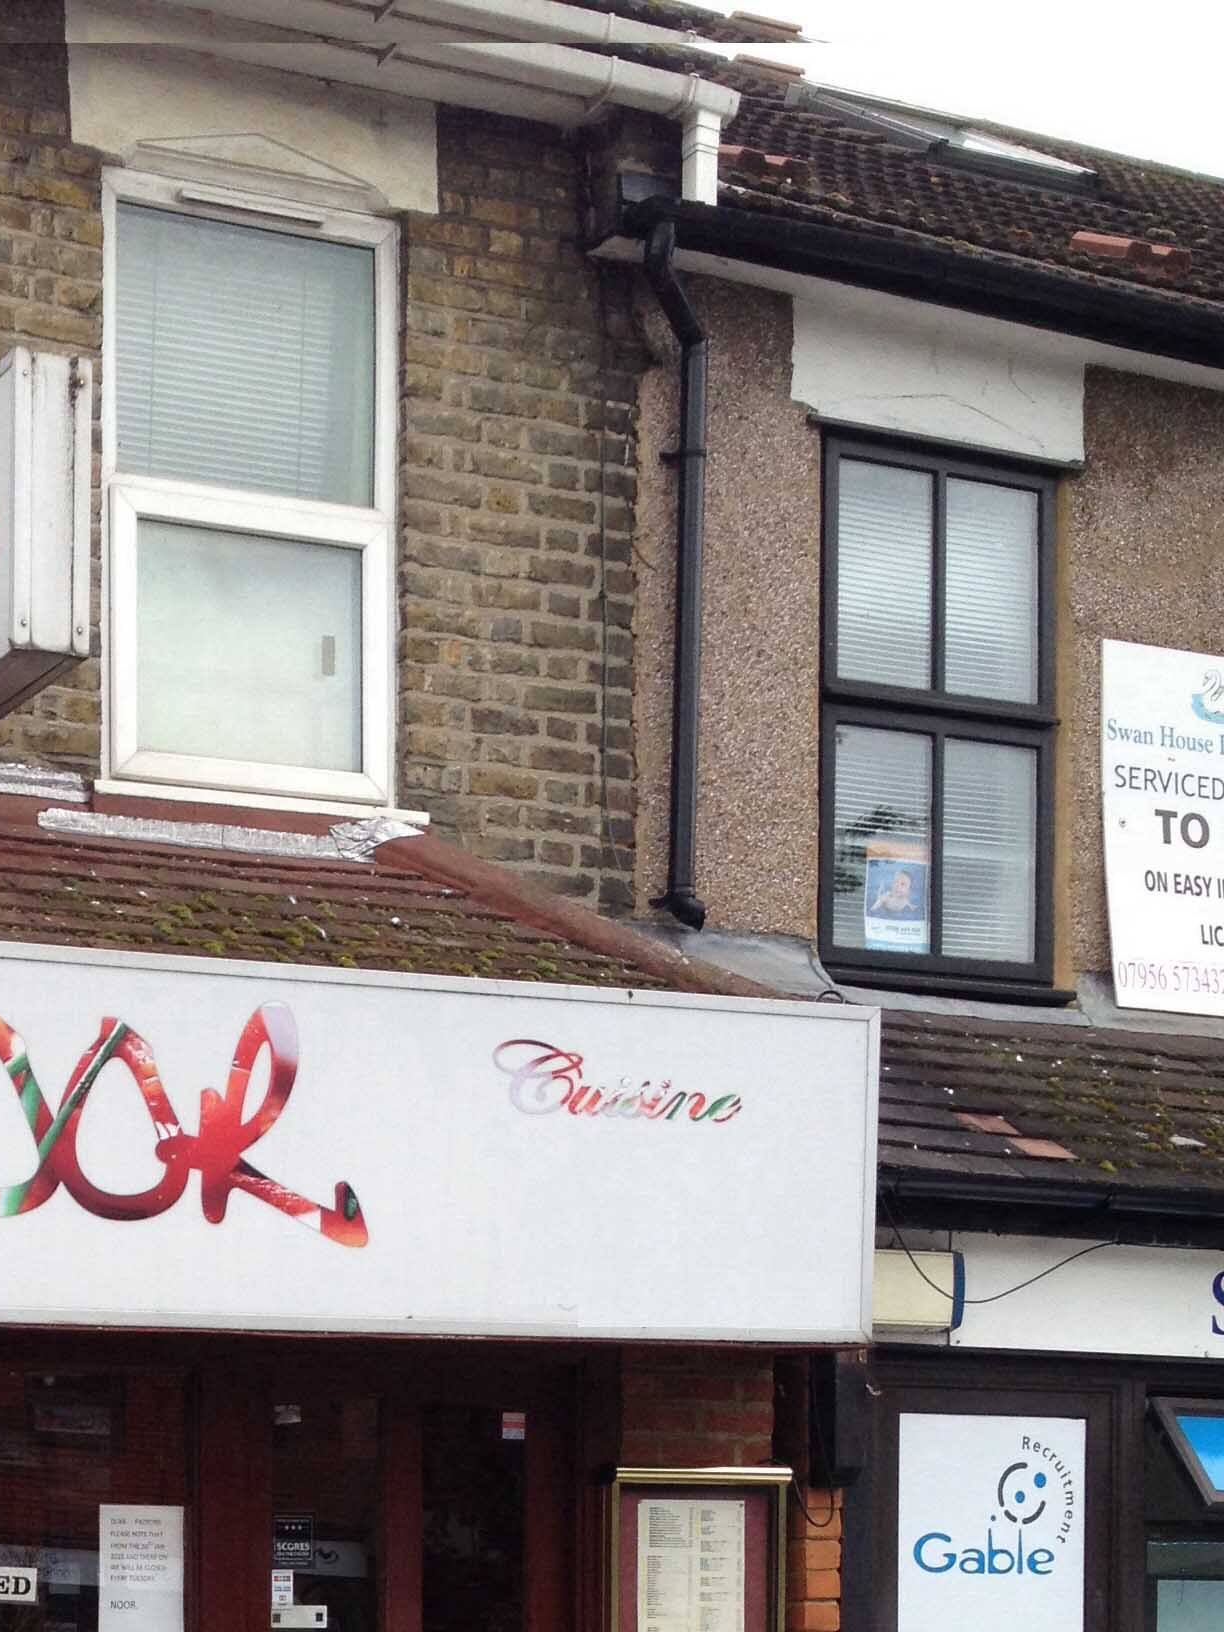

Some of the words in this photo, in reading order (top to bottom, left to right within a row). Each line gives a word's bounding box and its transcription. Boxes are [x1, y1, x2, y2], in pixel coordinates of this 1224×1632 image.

[1106, 717, 1155, 746] Swan
[1159, 724, 1214, 754] House
[1154, 808, 1210, 849] TO
[1144, 869, 1168, 893] ON
[1173, 872, 1212, 898] EASY
[1118, 960, 1168, 990] 07956
[493, 1038, 743, 1124] Cuisine
[1021, 1435, 1074, 1544] Recruitment
[913, 1527, 1055, 1575] Gable
